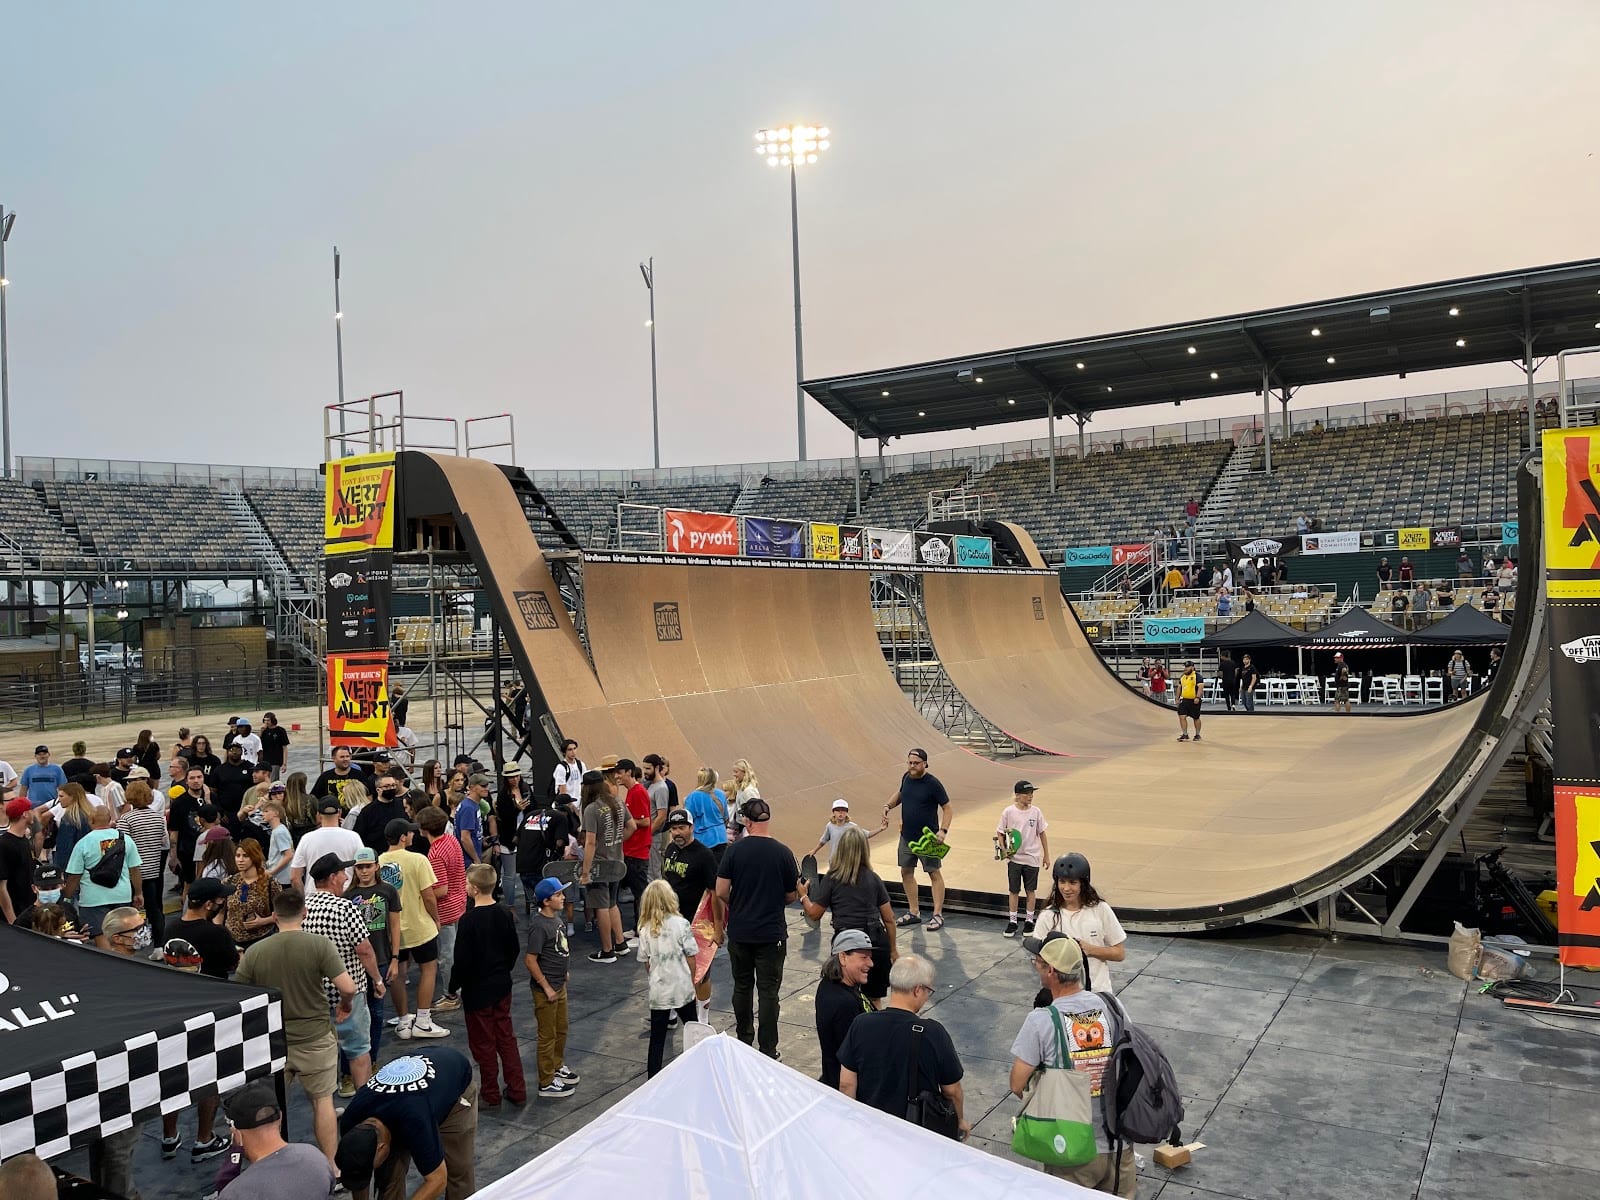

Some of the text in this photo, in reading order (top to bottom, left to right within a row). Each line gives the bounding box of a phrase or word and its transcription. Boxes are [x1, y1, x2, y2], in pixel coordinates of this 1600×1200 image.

[338, 484, 382, 507] VERT
[333, 502, 386, 525] ALERT
[817, 535, 834, 544] VERT
[844, 537, 859, 546] VERT
[1385, 534, 1394, 544] E
[817, 544, 837, 553] ALERT
[968, 550, 990, 561] GoDaddy
[1079, 552, 1110, 560] GoDaddy
[123, 561, 132, 570] Z
[519, 600, 552, 614] GATOR
[524, 613, 558, 628] SKINS
[655, 611, 679, 625] GATOR
[656, 625, 681, 640] SKINS
[1161, 625, 1202, 635] GoDaddy
[340, 680, 383, 701] VERT
[336, 699, 390, 719] ALERT
